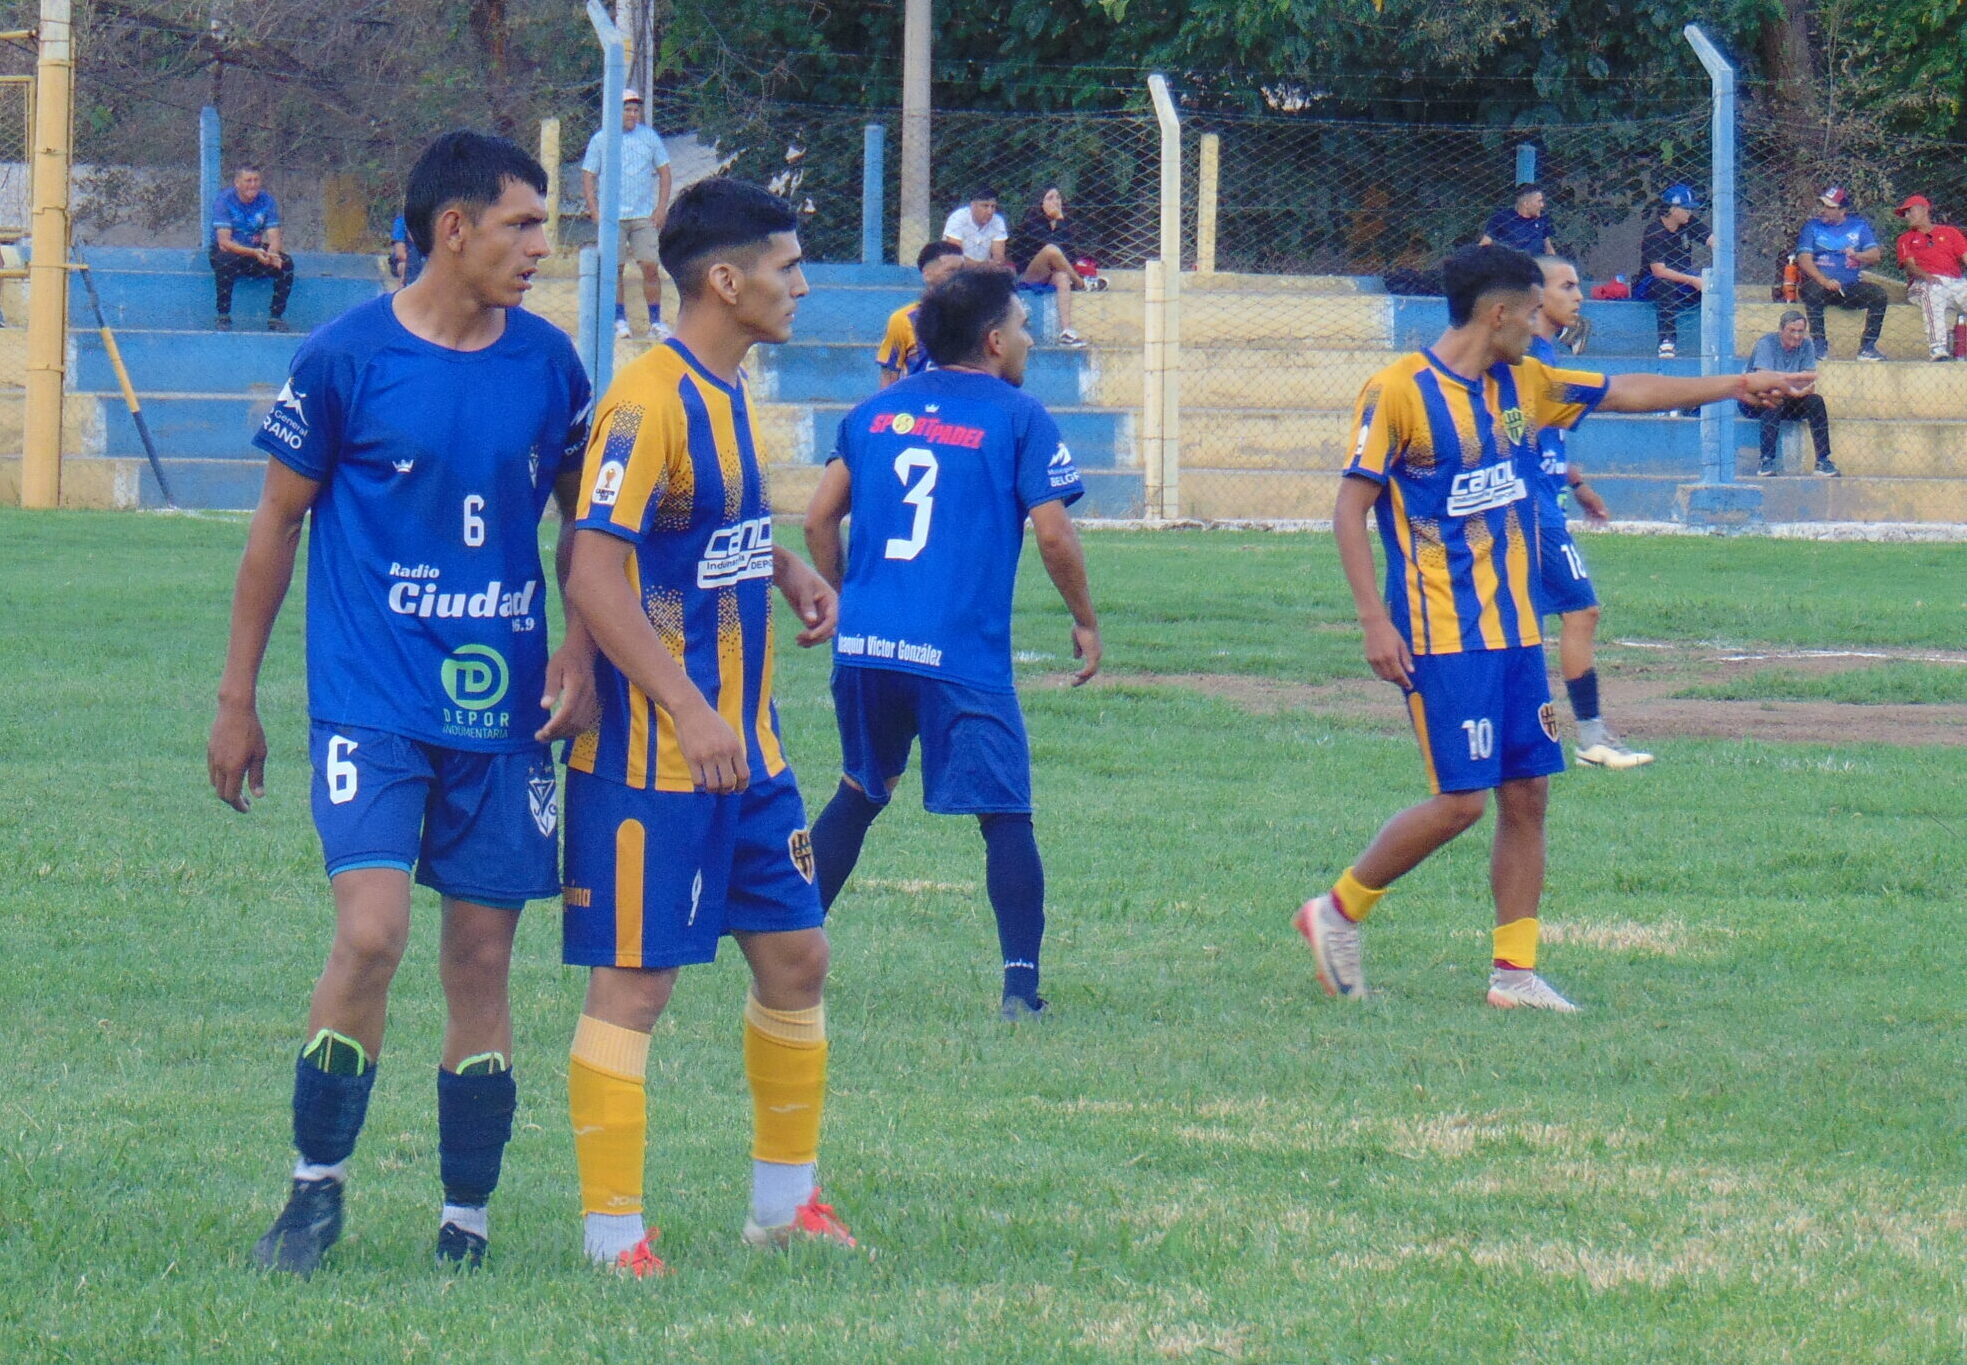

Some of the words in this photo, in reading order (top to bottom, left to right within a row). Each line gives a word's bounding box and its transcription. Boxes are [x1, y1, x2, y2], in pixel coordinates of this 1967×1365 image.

[274, 410, 308, 437] General
[463, 494, 485, 547] 6
[389, 561, 440, 579] Radio
[388, 580, 536, 618] Ciudad
[442, 707, 510, 728] DEPOR
[1461, 718, 1494, 760] 10
[326, 734, 359, 806] 6
